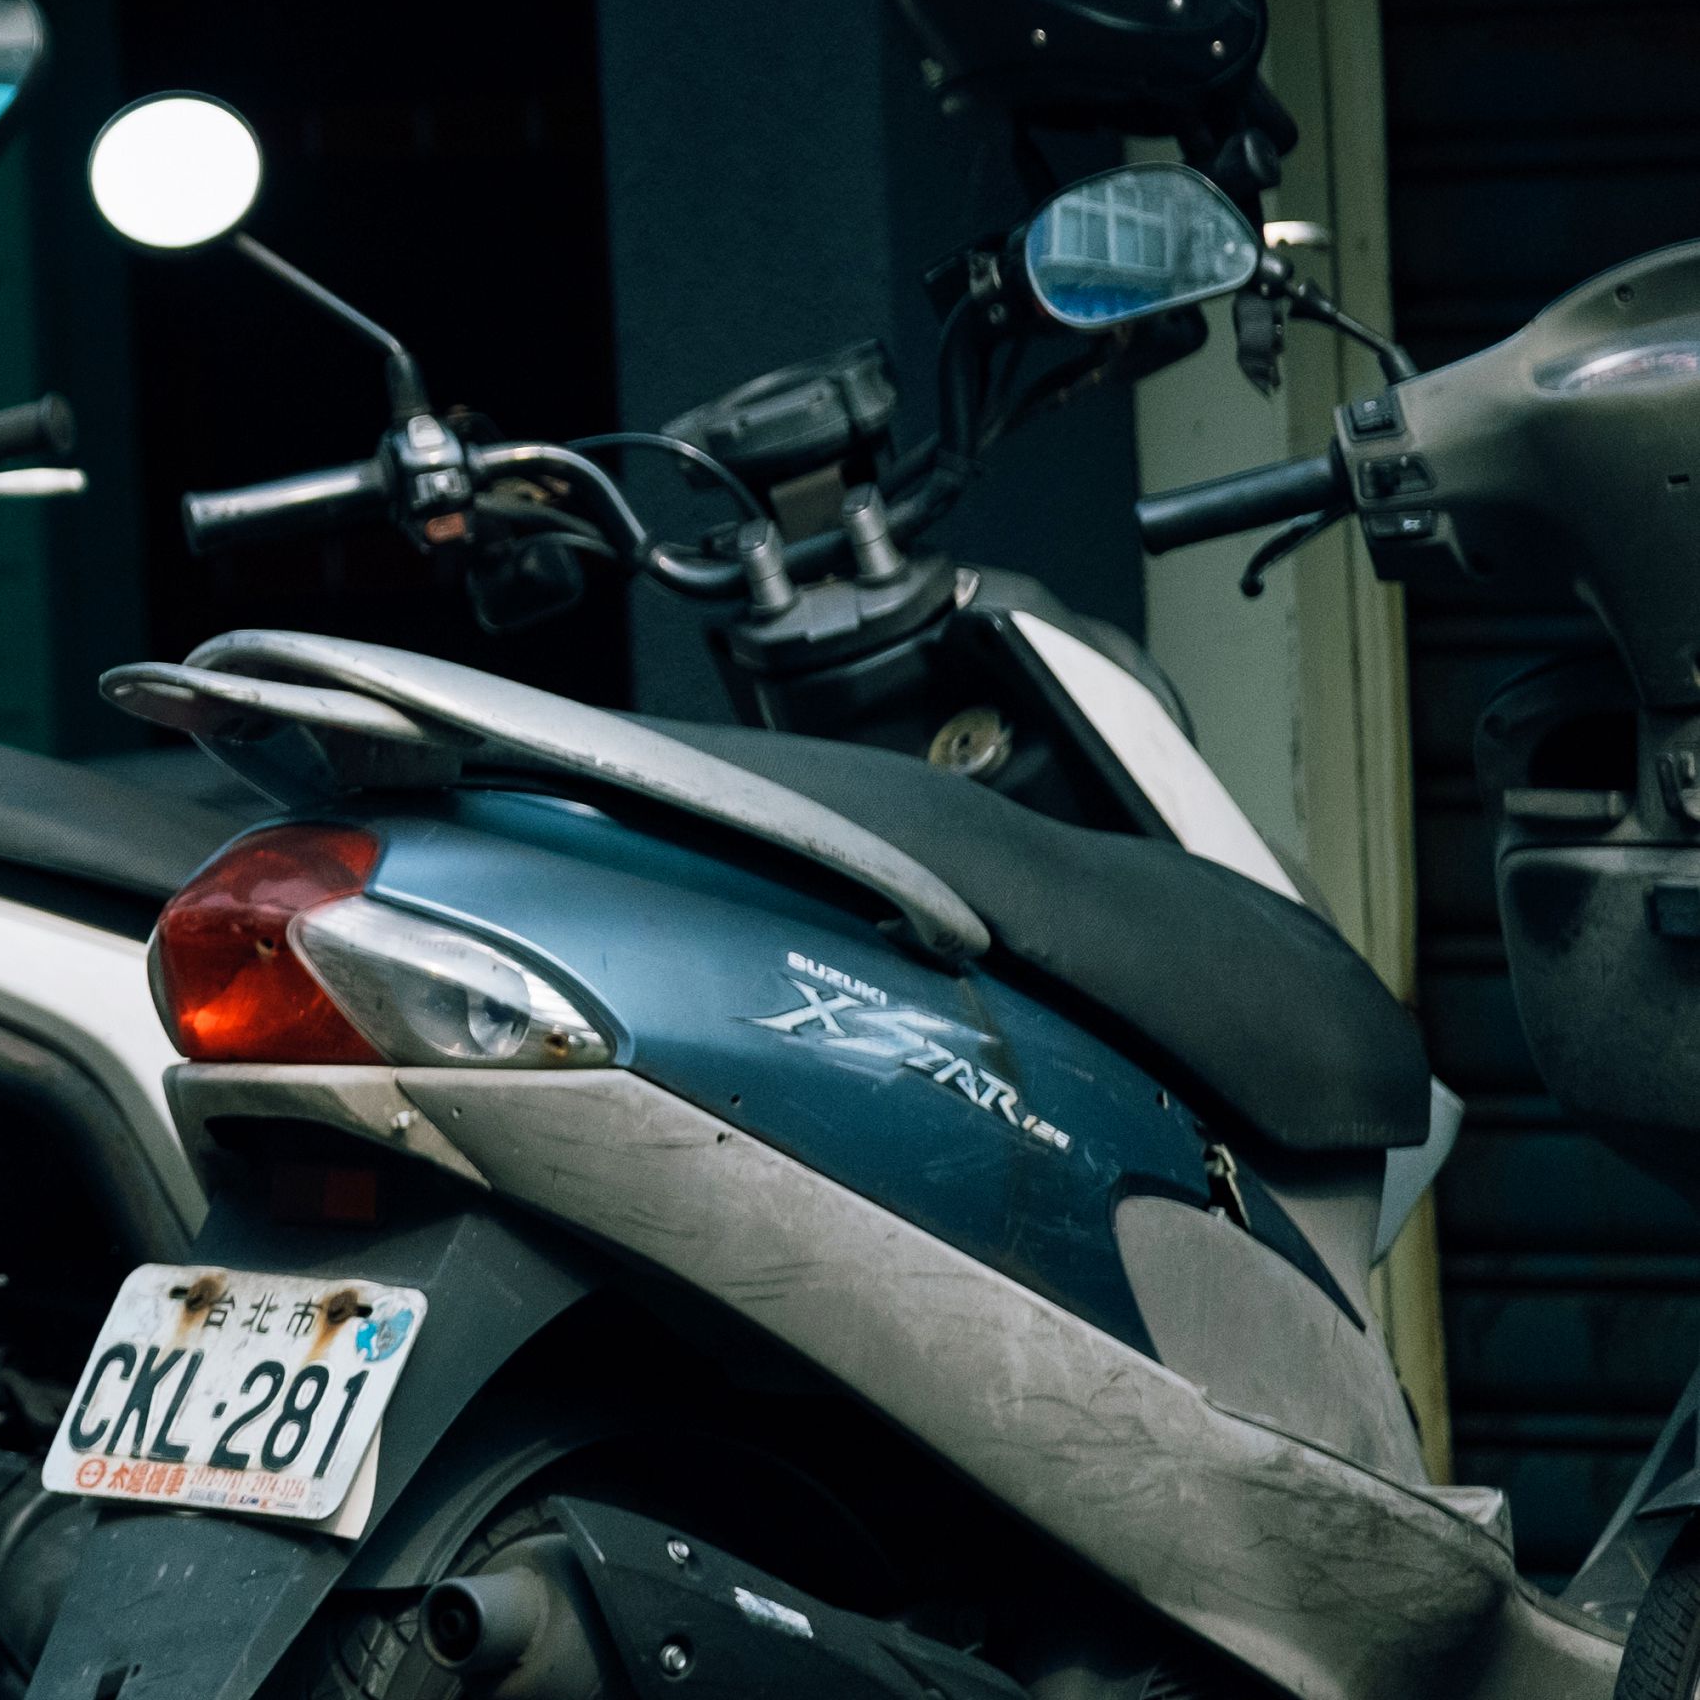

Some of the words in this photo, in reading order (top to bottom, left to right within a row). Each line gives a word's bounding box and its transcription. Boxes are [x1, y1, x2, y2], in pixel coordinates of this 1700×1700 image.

[786, 950, 888, 1006] SUZUKI
[201, 1290, 323, 1337] 台北市
